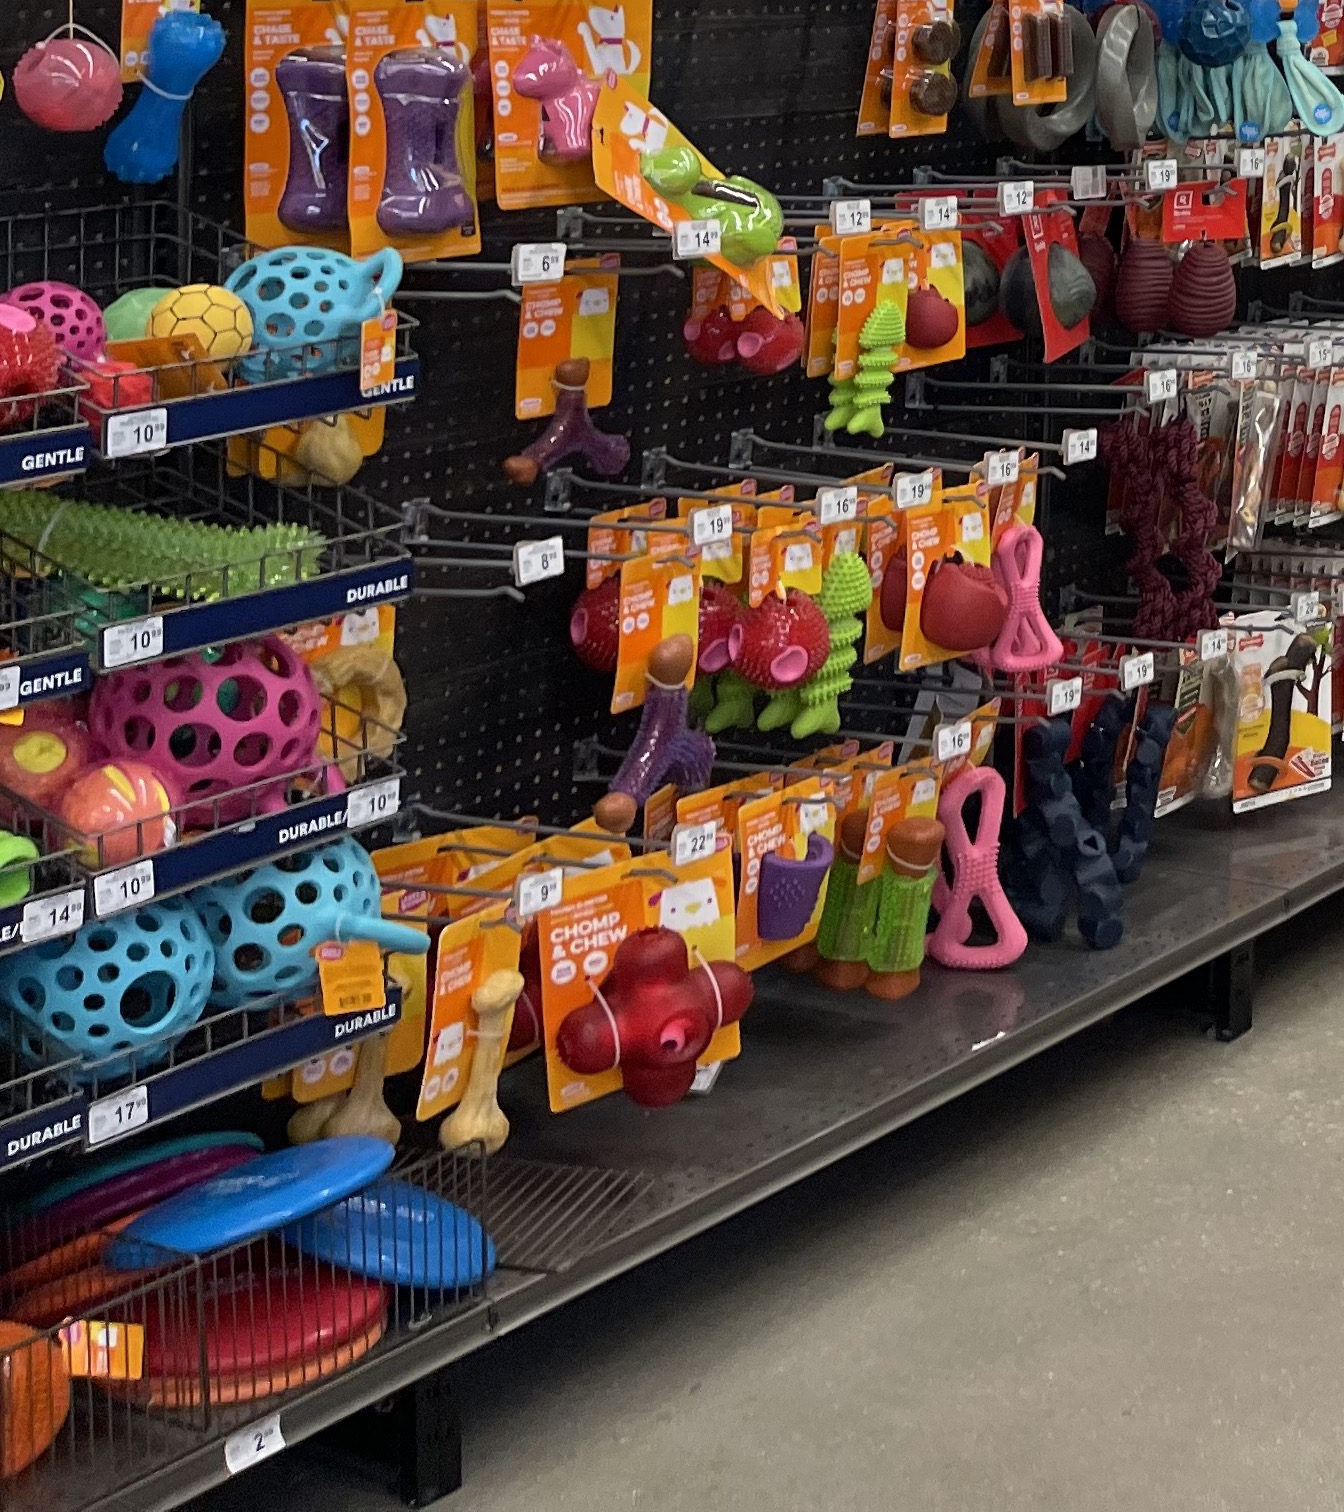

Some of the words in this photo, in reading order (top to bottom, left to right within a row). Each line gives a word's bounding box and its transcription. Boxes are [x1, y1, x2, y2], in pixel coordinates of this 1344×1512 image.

[21, 445, 85, 472] GENTLE
[346, 574, 409, 604] DURABLE
[19, 667, 83, 696] GENTLE
[550, 911, 621, 944] CHOMP
[570, 925, 629, 954] CHEW
[333, 1002, 397, 1039] DURABLE
[7, 1113, 82, 1157] DURABLE
